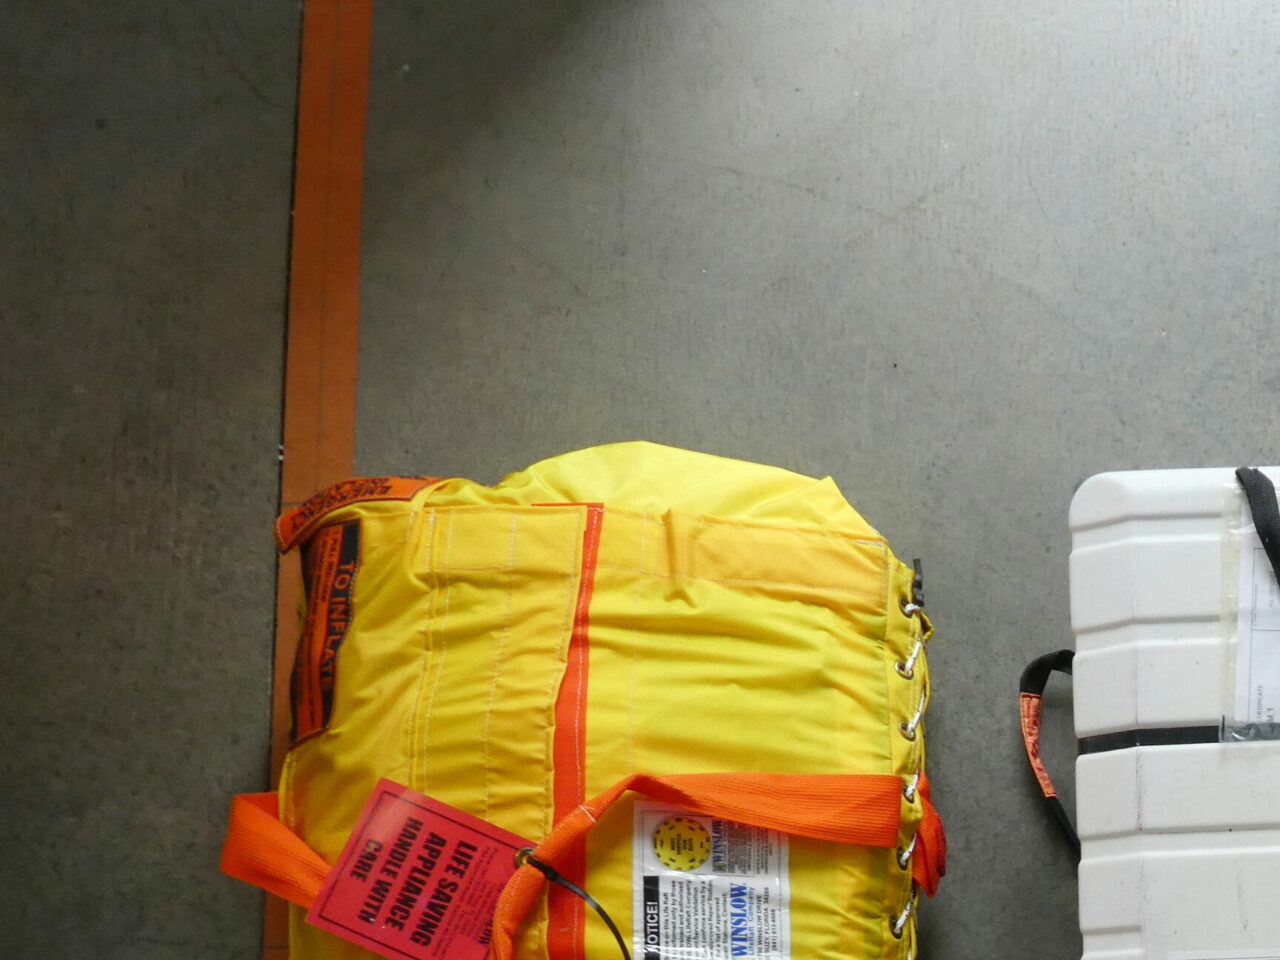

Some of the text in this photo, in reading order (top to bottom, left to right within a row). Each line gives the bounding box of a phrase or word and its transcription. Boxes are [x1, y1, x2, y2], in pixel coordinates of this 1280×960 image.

[335, 560, 353, 591] TO
[349, 837, 384, 883] CARE
[357, 816, 423, 925] HANDLE WITH
[384, 831, 447, 932] APPLIANCE
[409, 839, 478, 948] LIFE SAVING
[730, 881, 747, 956] WINSLOW
